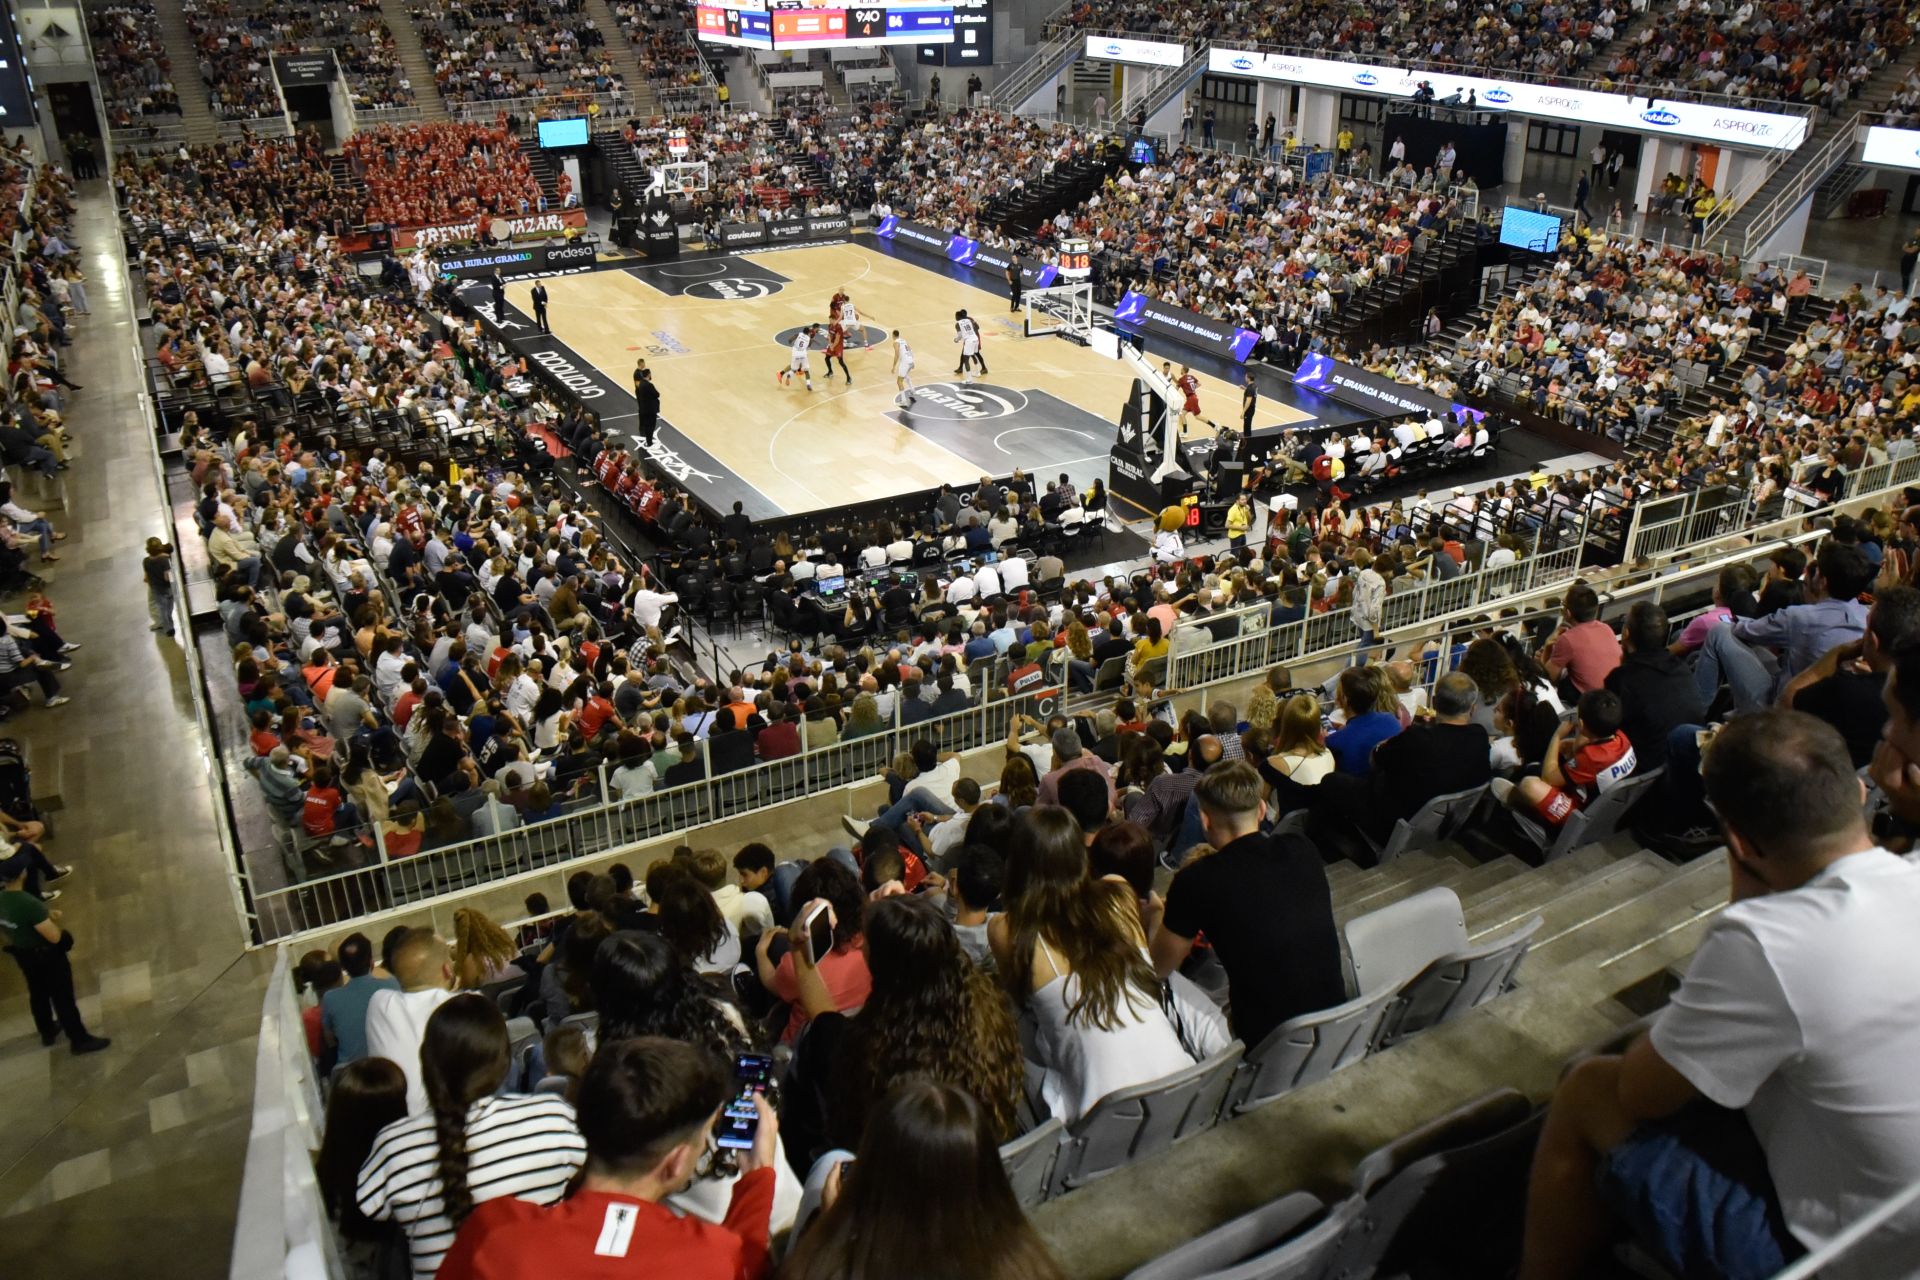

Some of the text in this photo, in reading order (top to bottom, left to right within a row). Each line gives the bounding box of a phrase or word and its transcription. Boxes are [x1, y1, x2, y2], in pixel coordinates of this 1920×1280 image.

[863, 23, 871, 35] 4
[414, 223, 477, 249] FRENTE
[547, 245, 592, 261] endesa
[1061, 253, 1071, 268] 18
[1074, 254, 1089, 268] 18
[441, 260, 463, 271] CAJA
[464, 257, 494, 269] RURAL
[1144, 310, 1223, 343] DE GRANADA PARA GRANADA
[1332, 375, 1343, 384] DE
[1343, 379, 1378, 398] GRANADA
[1378, 391, 1400, 406] PARA
[915, 387, 990, 419] PULEVA
[1124, 461, 1145, 479] RURAL
[1187, 508, 1200, 526] 18
[1019, 673, 1041, 686] PULEVA
[1038, 697, 1054, 717] C
